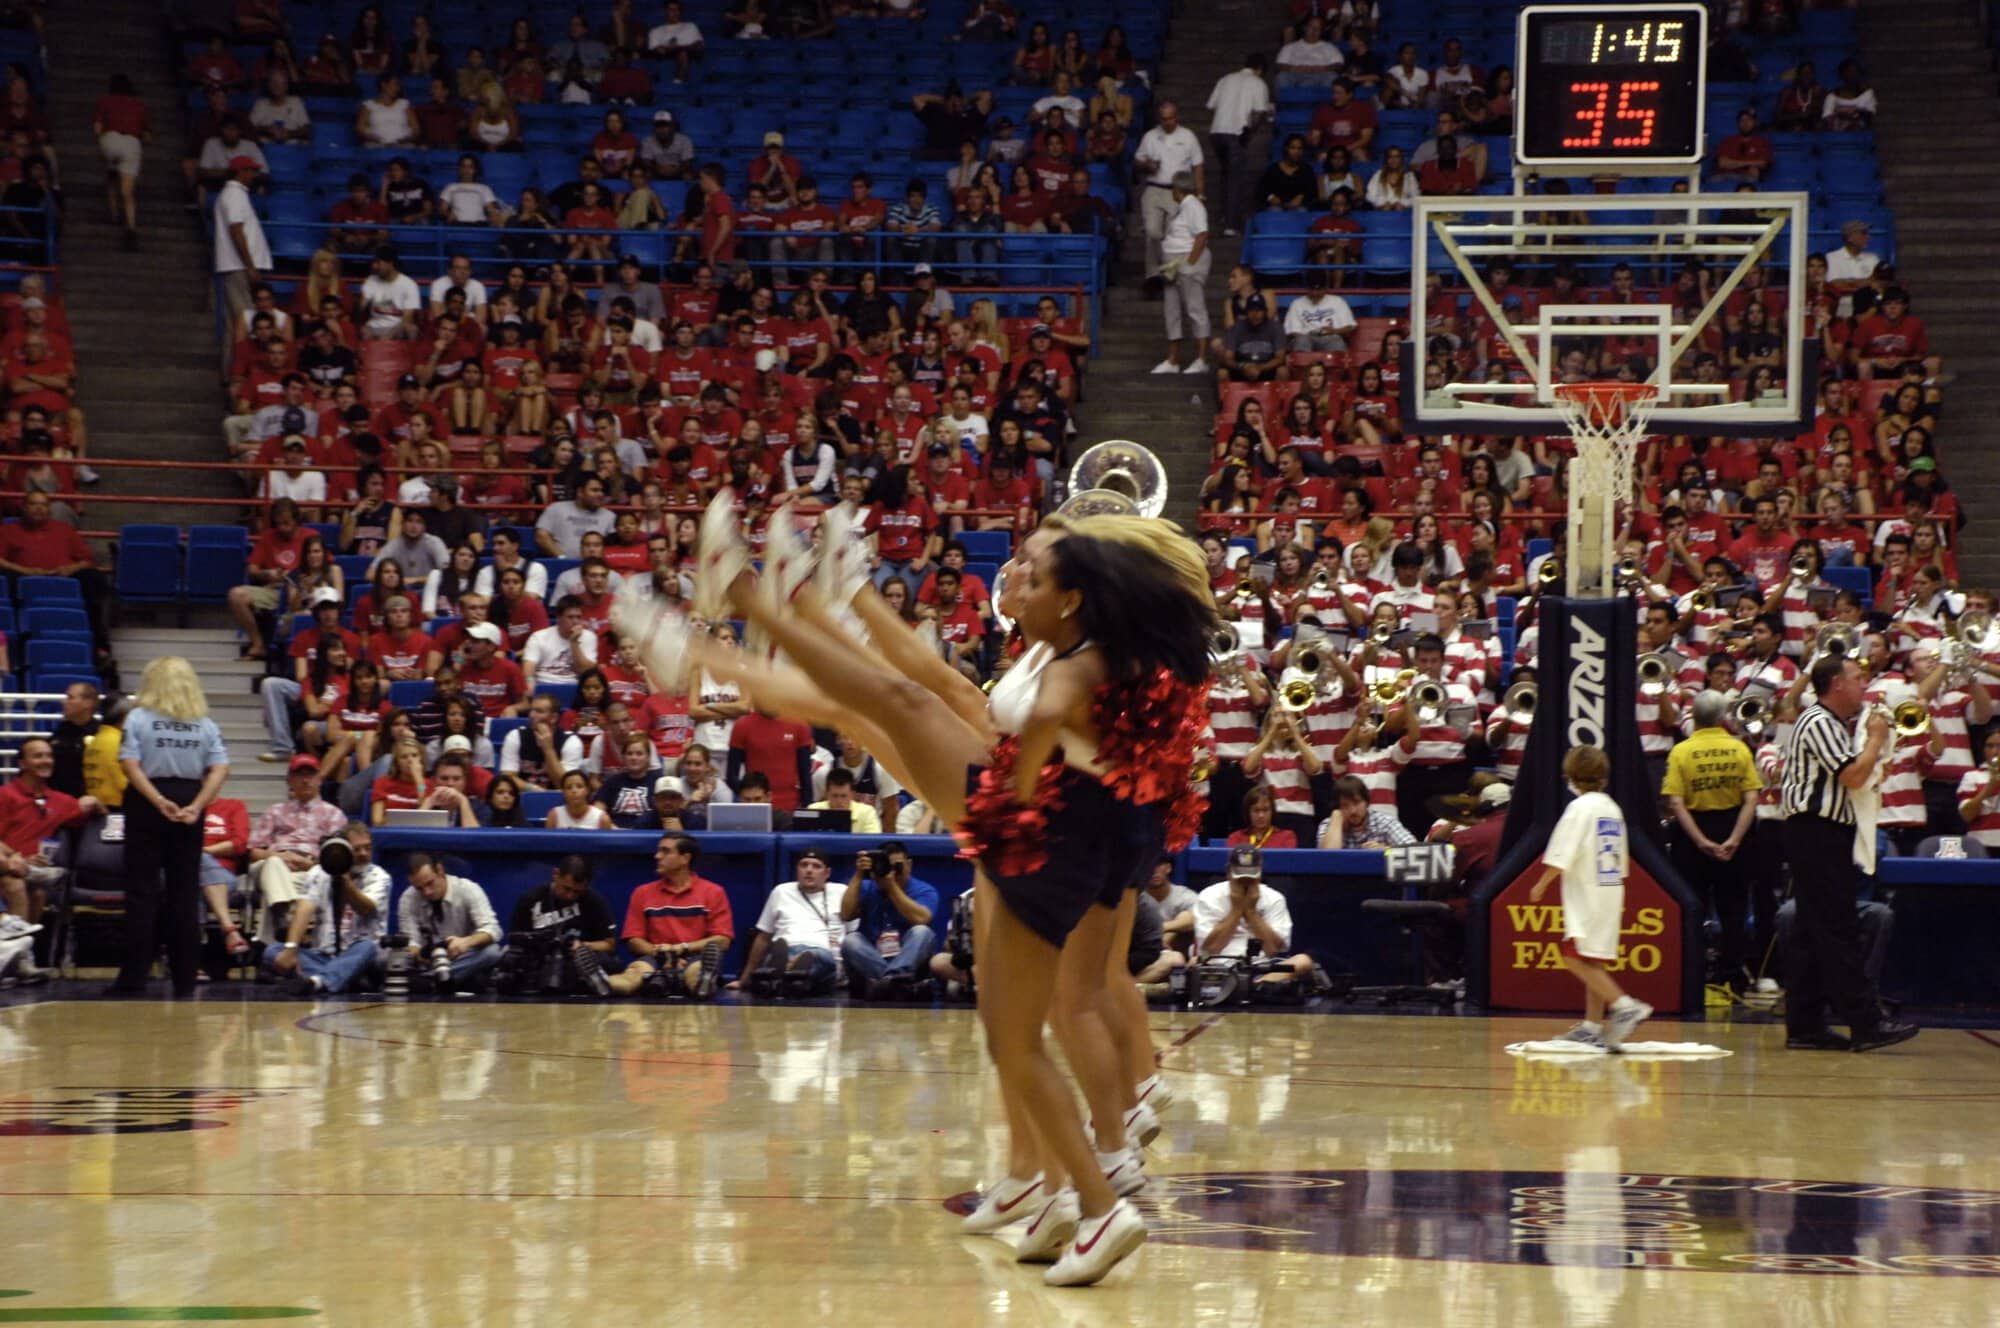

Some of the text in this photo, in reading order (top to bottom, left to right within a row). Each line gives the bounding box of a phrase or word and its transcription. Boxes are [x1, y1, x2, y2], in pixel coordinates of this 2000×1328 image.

[1590, 23, 1683, 63] 1:45
[1562, 81, 1660, 148] 35
[1568, 614, 1606, 750] ARIZO
[151, 720, 201, 732] EVENT
[155, 737, 200, 749] STAFF
[1692, 748, 1737, 759] EVENT
[1696, 762, 1737, 773] STAFF
[1386, 844, 1456, 880] FSN
[1511, 941, 1662, 973] FAGO
